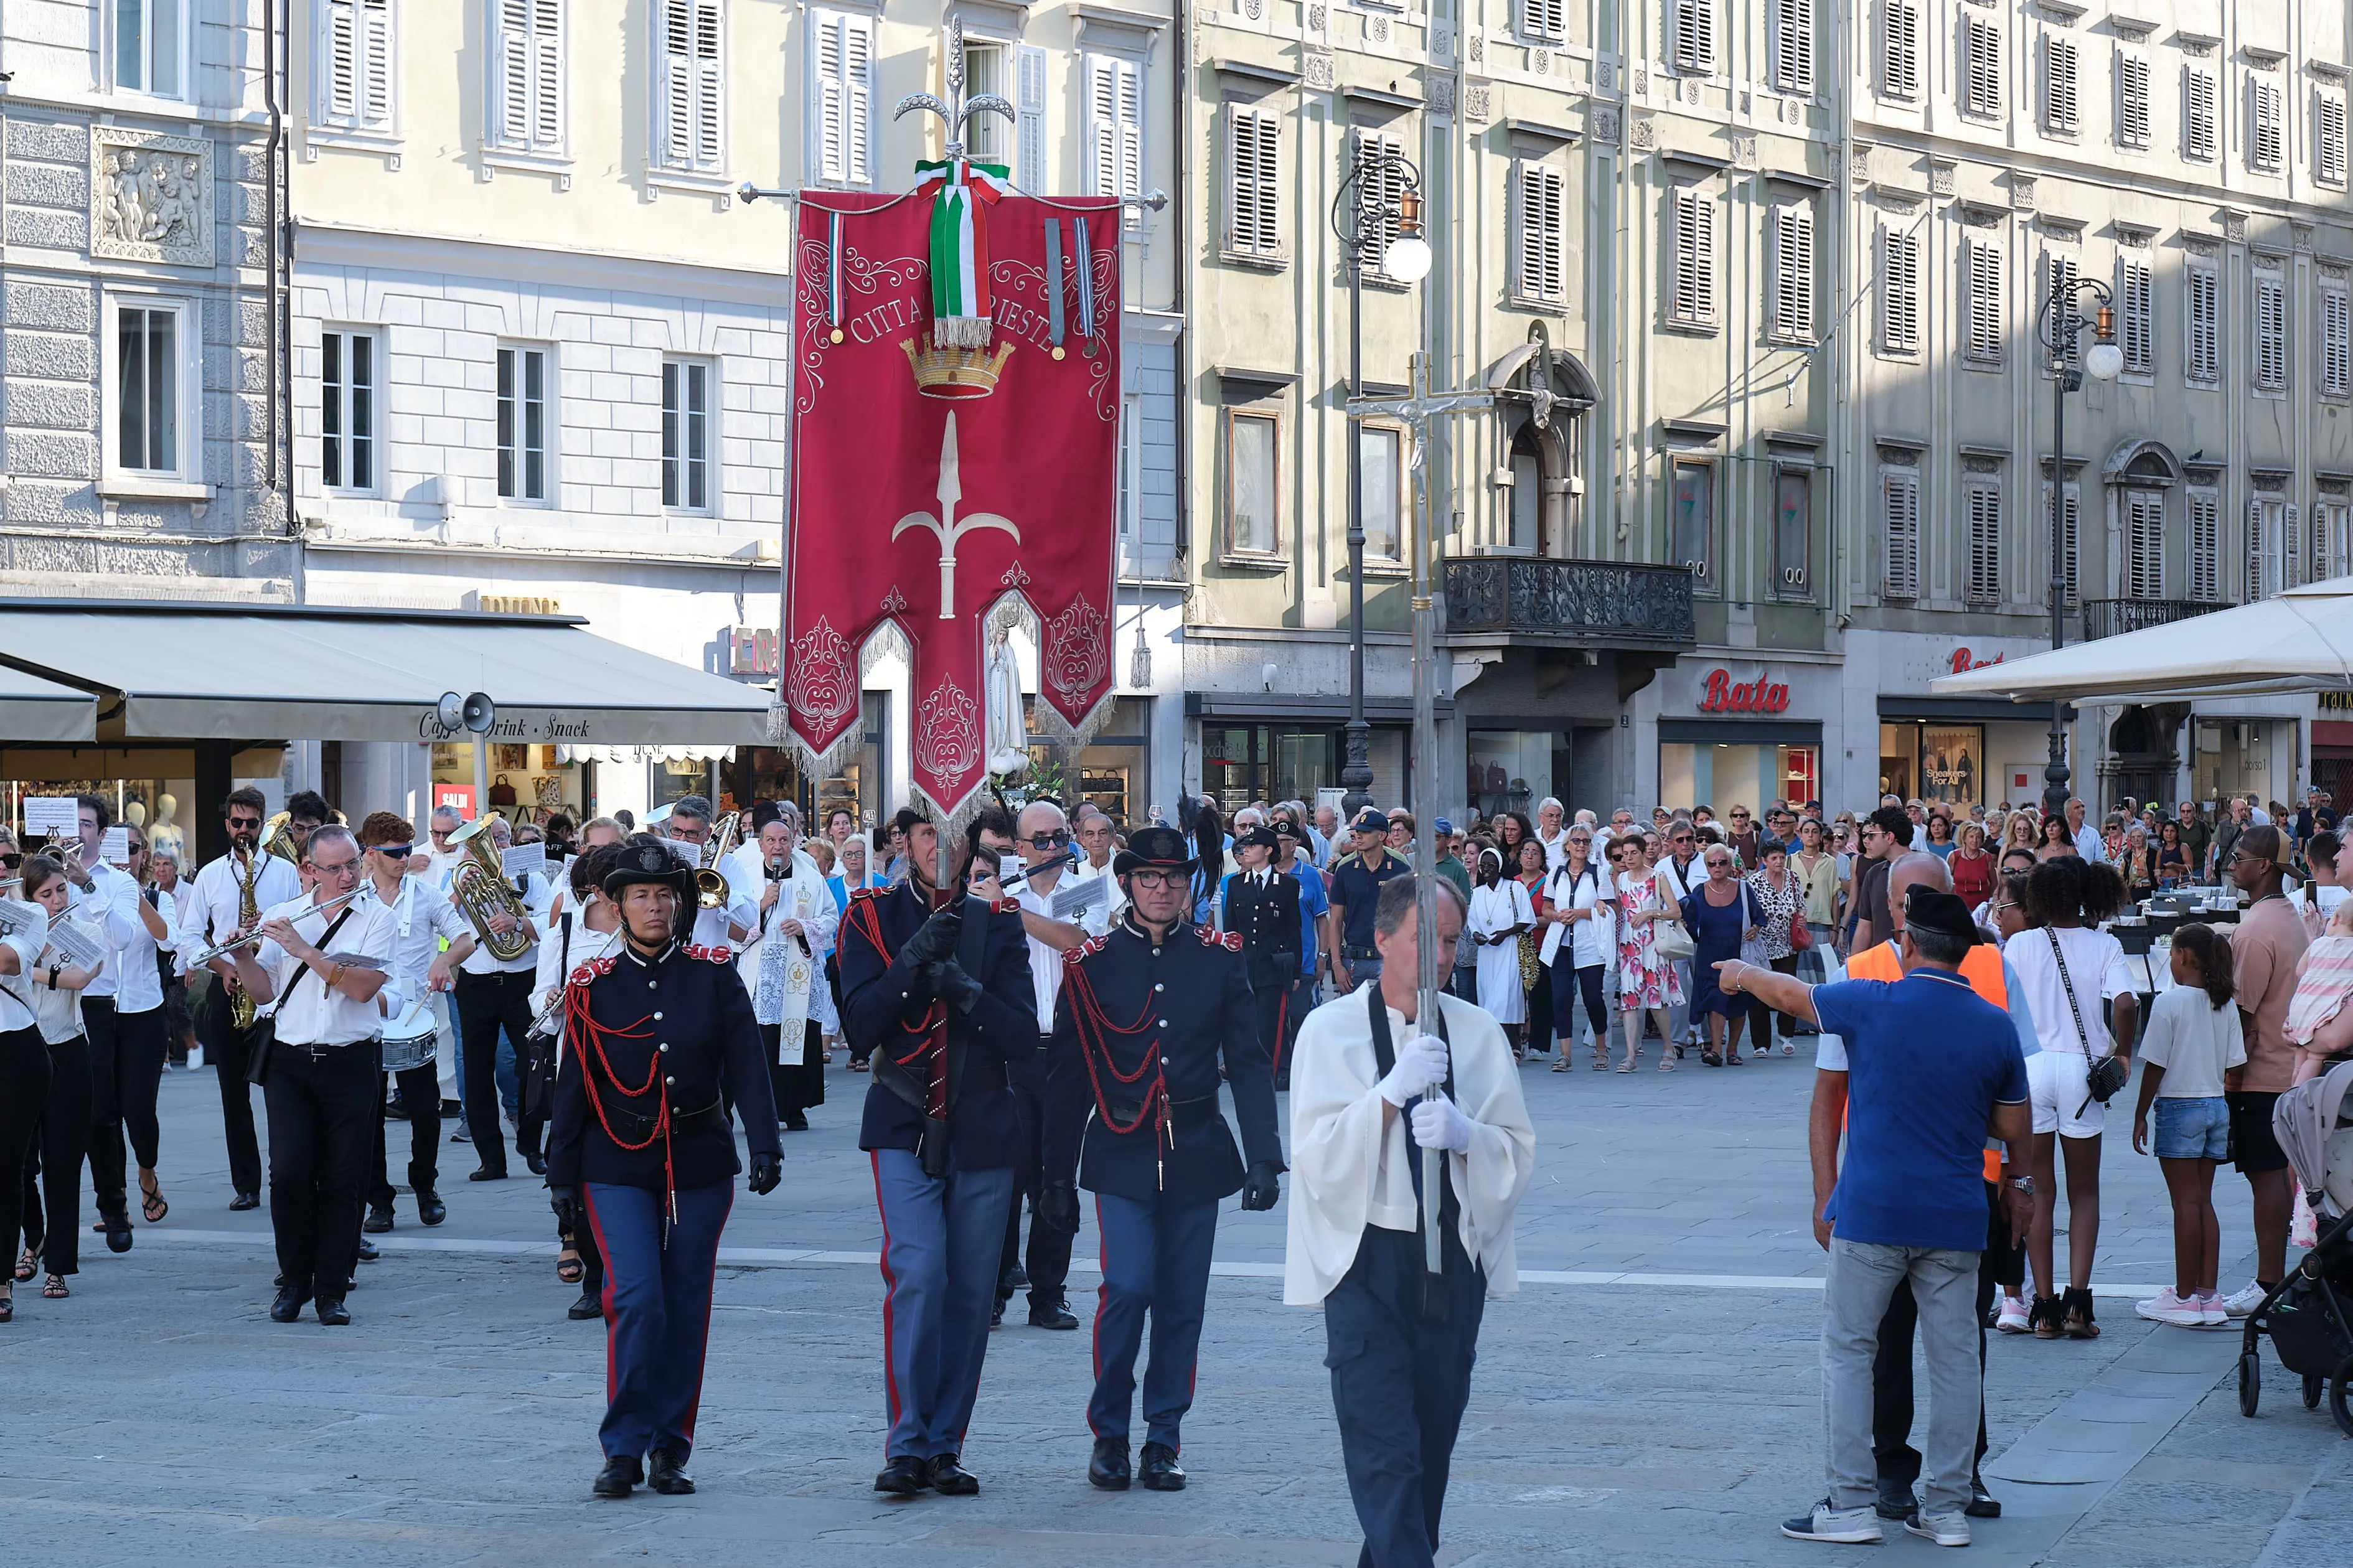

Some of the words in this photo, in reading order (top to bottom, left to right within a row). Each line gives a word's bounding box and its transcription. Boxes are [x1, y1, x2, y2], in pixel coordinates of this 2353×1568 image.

[1700, 669, 1790, 712] Bata
[543, 713, 590, 740] Snack
[1927, 768, 1966, 777] Sneakers
[1932, 776, 1947, 785] For
[1948, 776, 1959, 785] All
[442, 792, 468, 809] SALDI
[2060, 964, 2071, 988] FOREVER
